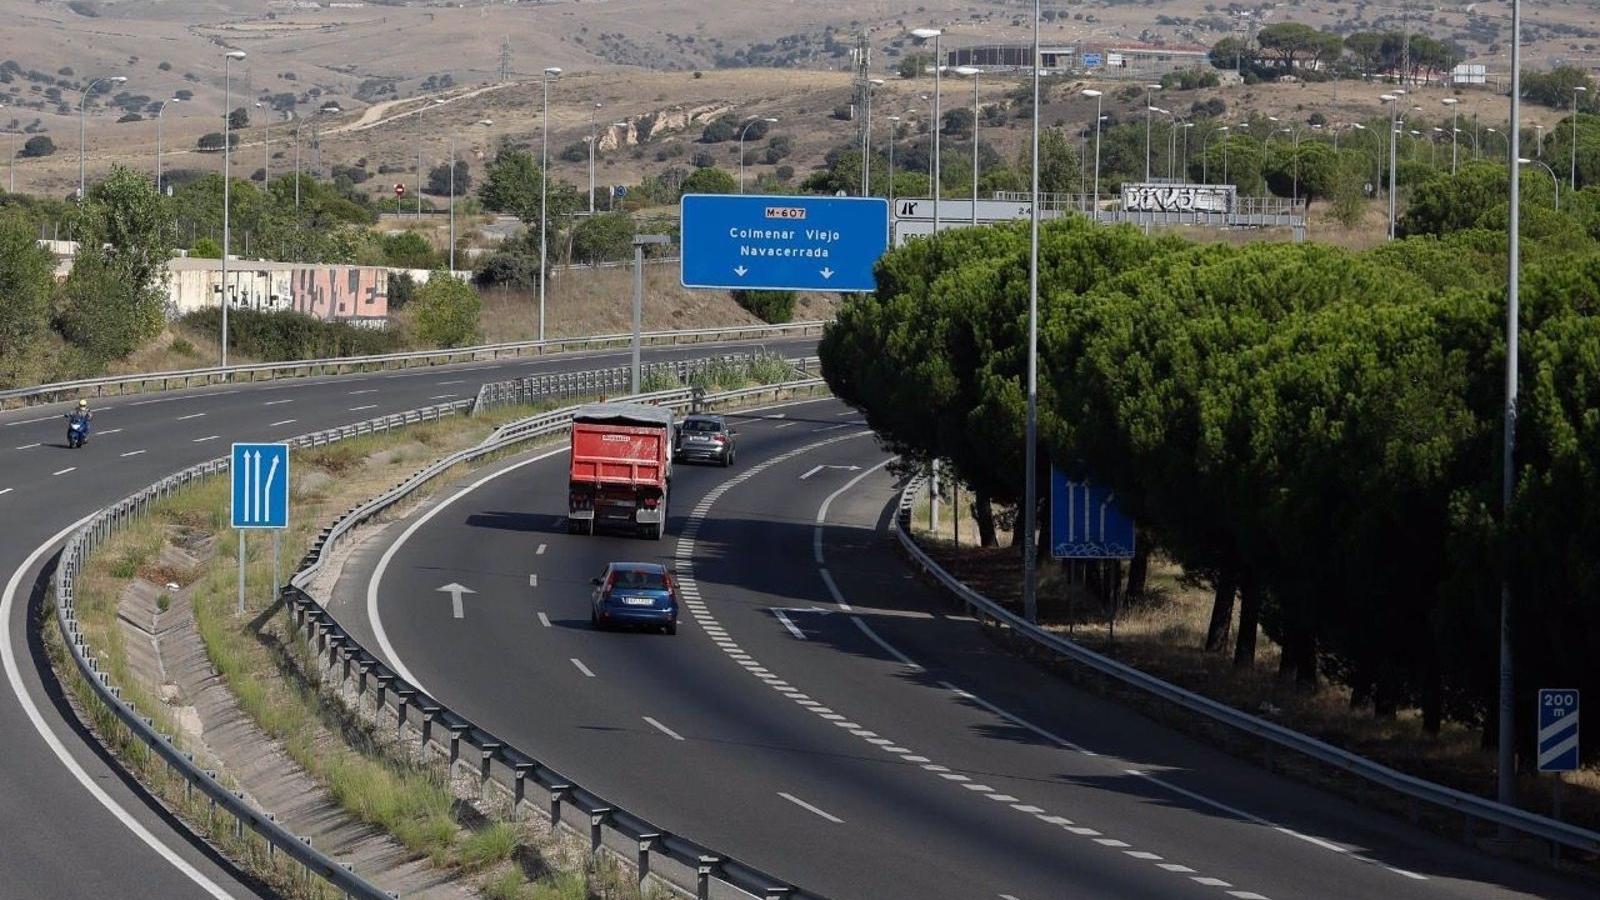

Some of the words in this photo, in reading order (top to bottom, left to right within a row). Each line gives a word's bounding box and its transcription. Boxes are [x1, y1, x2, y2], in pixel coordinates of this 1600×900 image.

[766, 209, 805, 218] M-607
[729, 227, 795, 240] Colmenar
[806, 229, 840, 243] Viejo
[740, 245, 829, 258] Navacerrada
[1544, 694, 1574, 706] 200
[1553, 708, 1565, 717] m
